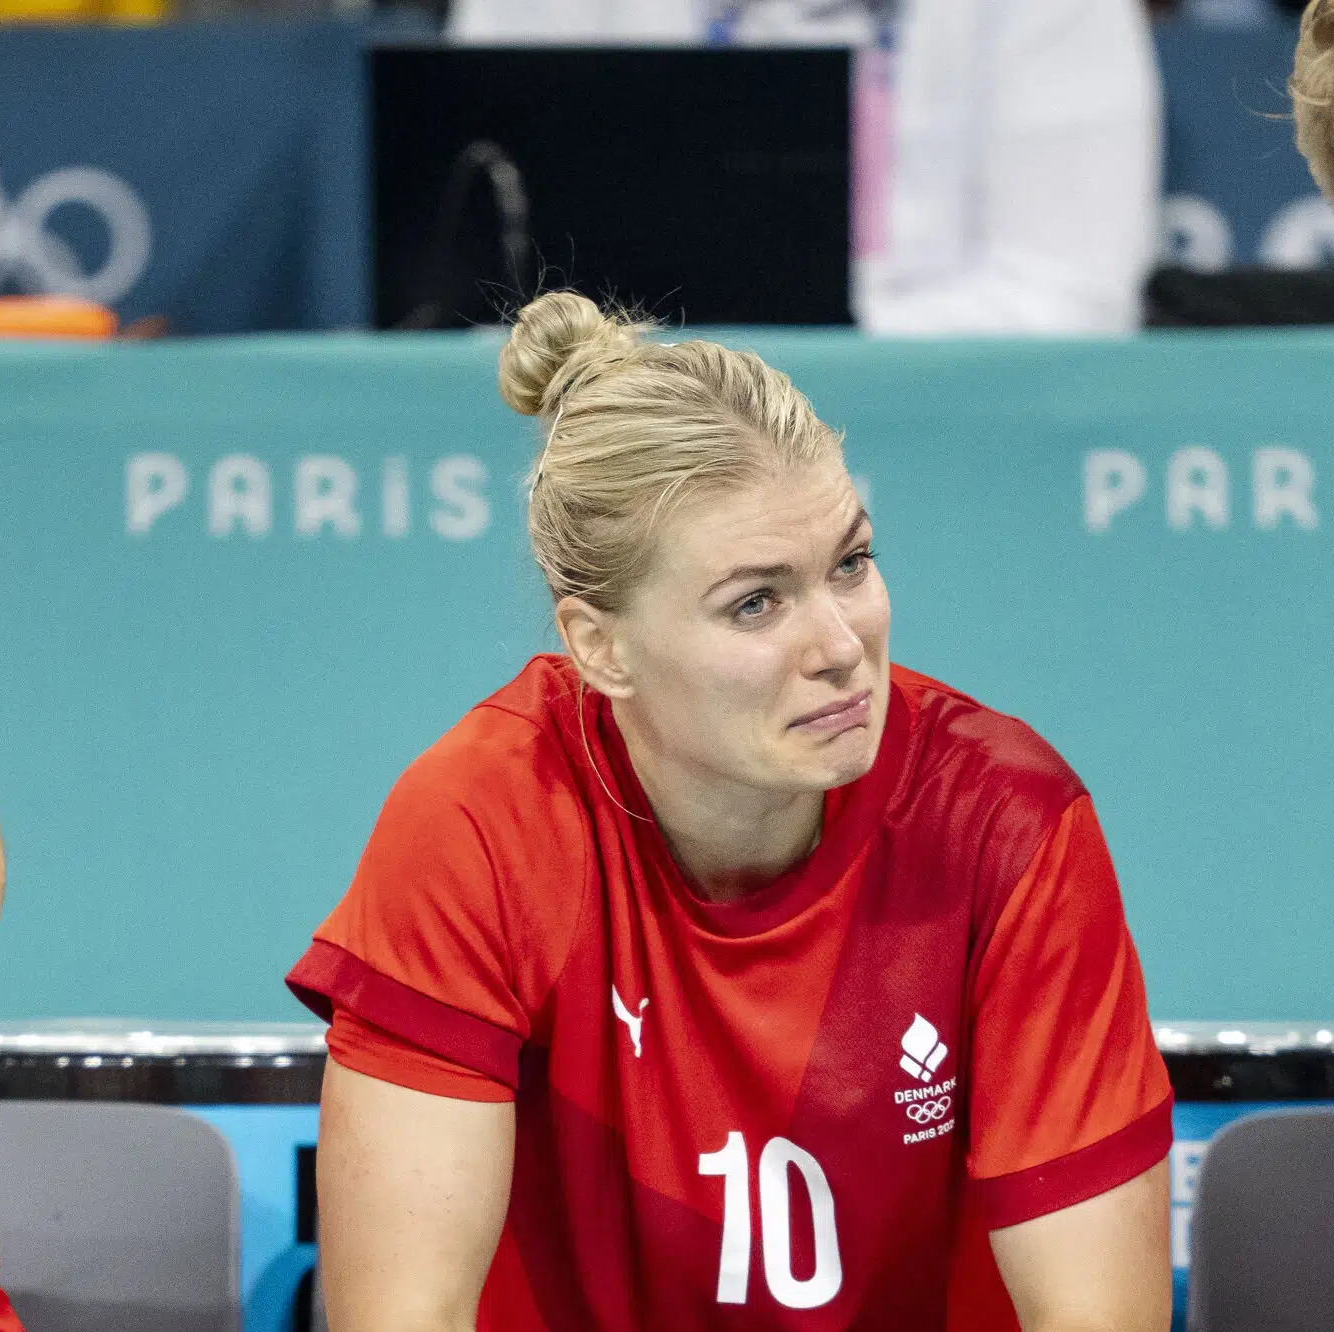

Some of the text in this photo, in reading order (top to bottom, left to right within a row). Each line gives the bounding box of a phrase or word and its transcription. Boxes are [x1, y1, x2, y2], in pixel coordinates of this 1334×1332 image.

[125, 451, 492, 541] PARIS
[894, 1076, 957, 1105] DENMARK
[903, 1117, 956, 1145] PARIS 202
[698, 1130, 844, 1310] 10
